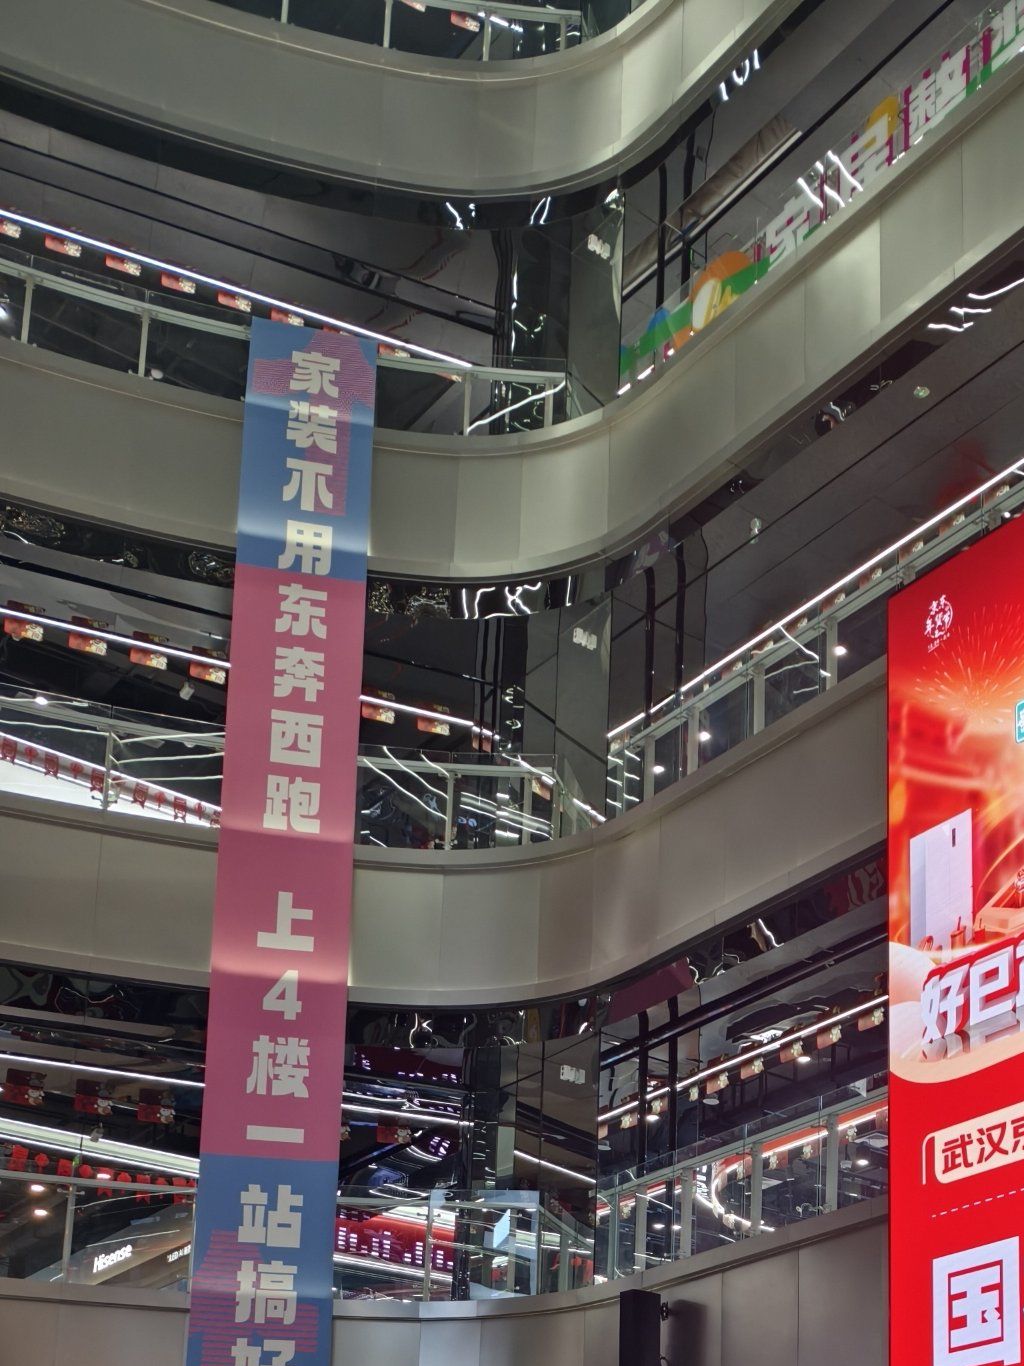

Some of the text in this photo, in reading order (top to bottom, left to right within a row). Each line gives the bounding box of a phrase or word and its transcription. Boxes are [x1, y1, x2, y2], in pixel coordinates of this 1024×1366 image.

[262, 350, 341, 834] 家装不用东奔西跑
[93, 1243, 134, 1275] Hisense
